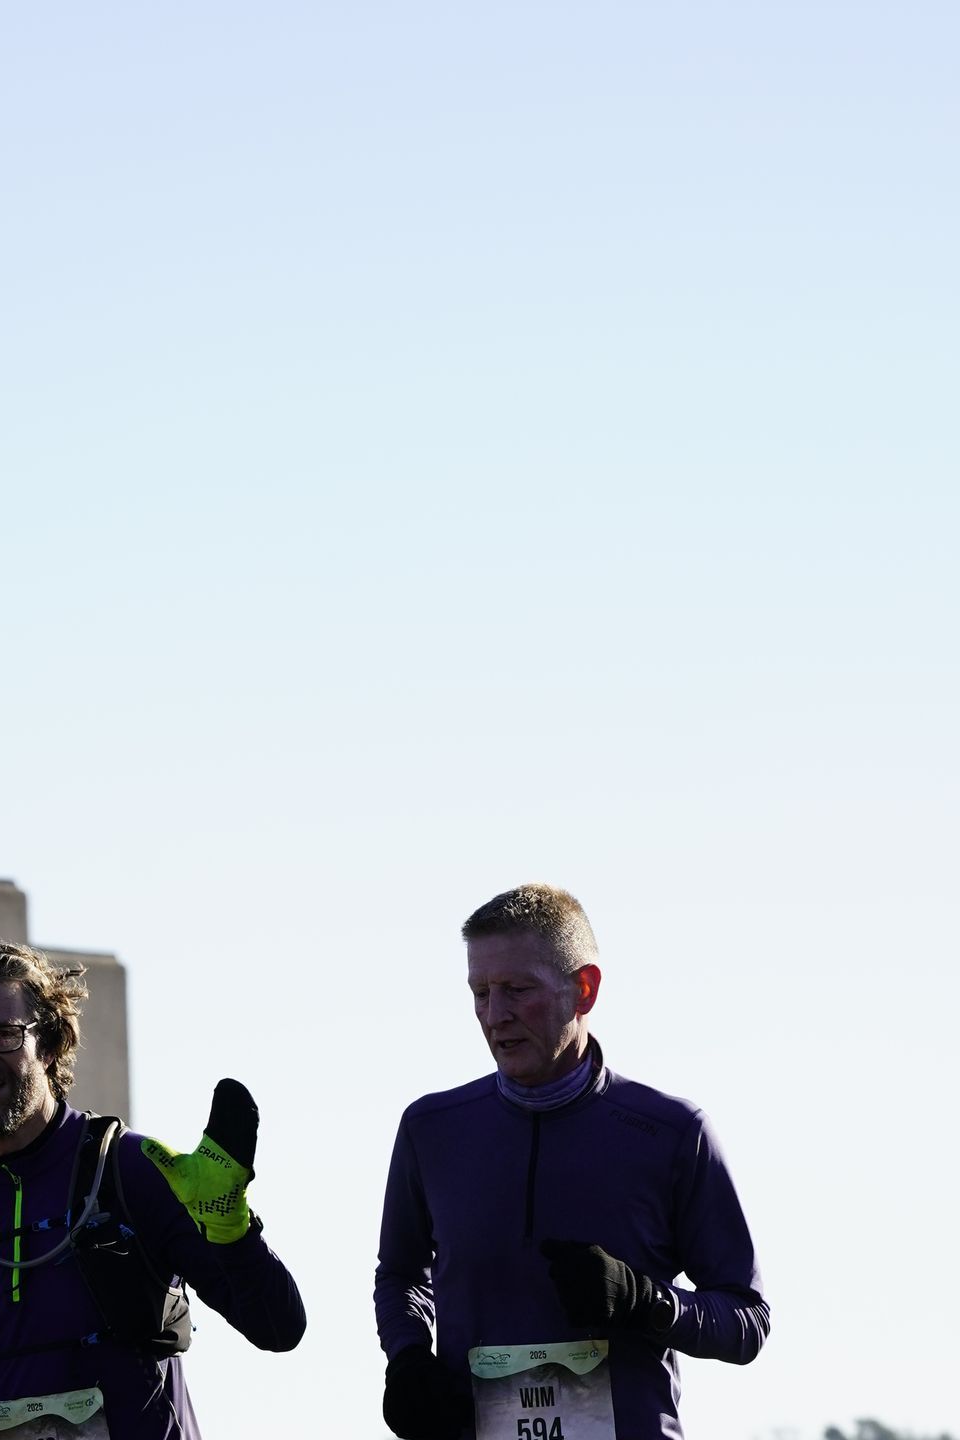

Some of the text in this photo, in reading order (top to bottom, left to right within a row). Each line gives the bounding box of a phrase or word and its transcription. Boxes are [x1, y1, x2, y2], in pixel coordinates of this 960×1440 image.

[198, 1145, 226, 1165] CRAFT
[529, 1350, 547, 1360] 2025
[519, 1386, 555, 1408] WIM
[26, 1402, 44, 1412] 2025
